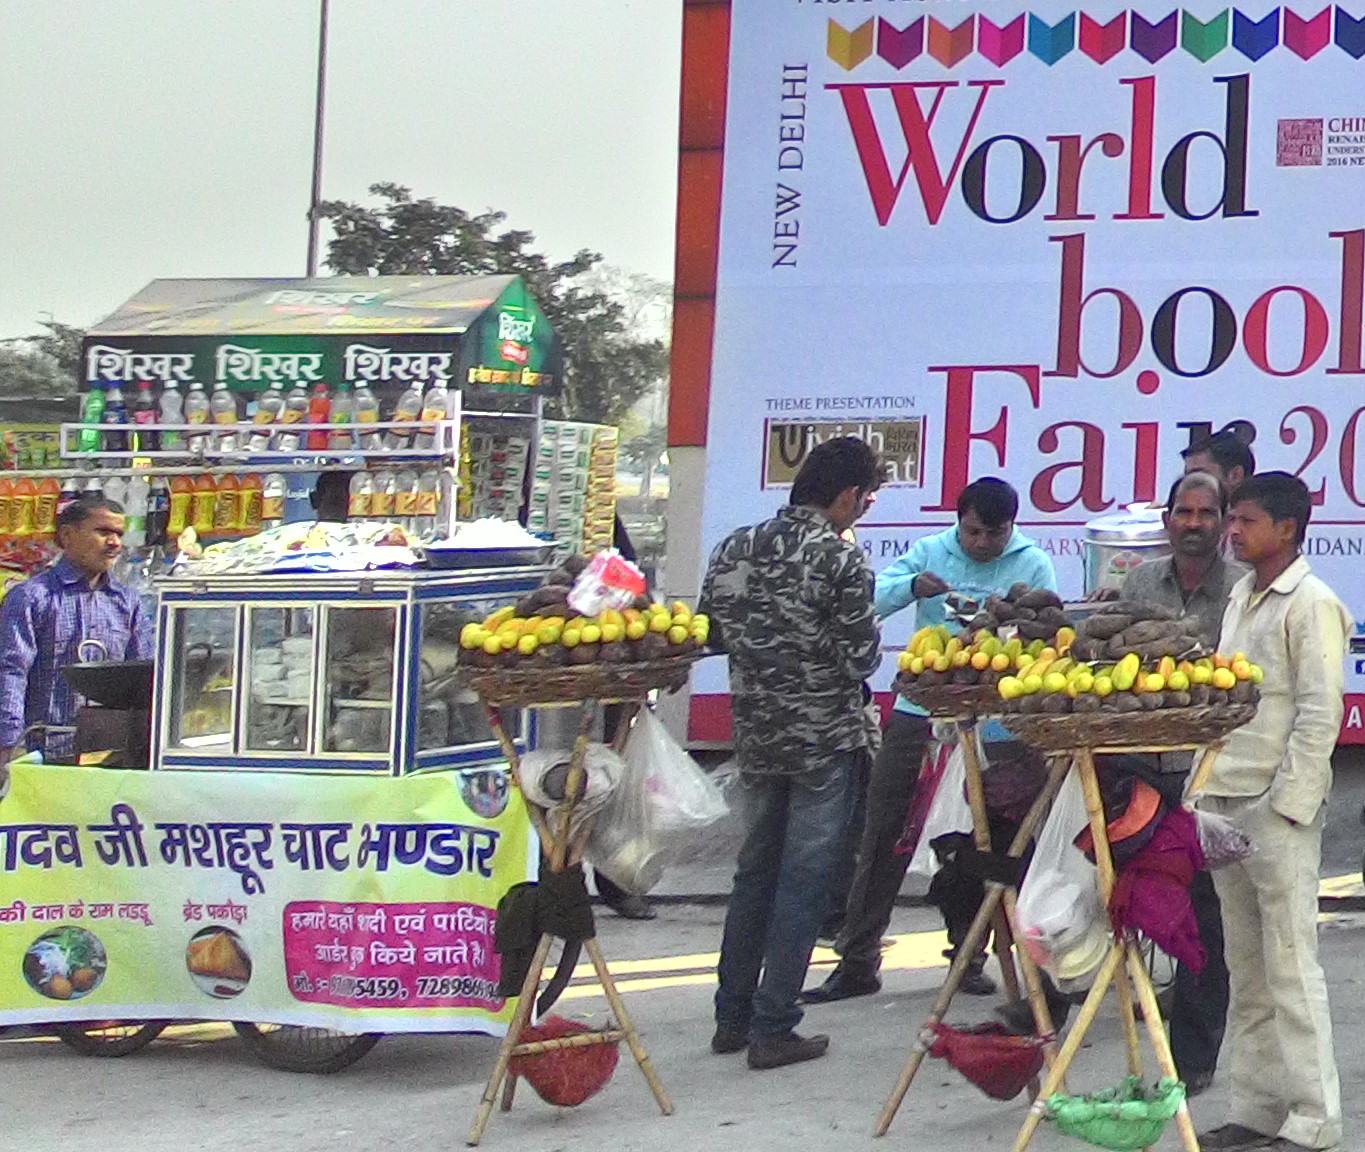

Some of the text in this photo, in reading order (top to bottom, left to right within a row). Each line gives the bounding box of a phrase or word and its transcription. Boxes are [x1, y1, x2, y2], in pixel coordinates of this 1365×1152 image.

[772, 62, 809, 270] NEW DELHI
[823, 73, 1260, 227] World
[1327, 157, 1348, 167] 2016
[86, 344, 195, 381] शिखर
[214, 343, 324, 382] शिखर
[343, 343, 453, 381] शिखर
[766, 396, 915, 411] THEME PRESENTATION
[880, 539, 909, 557] PM
[87, 803, 501, 895] जी मशहूर चाट भण्डार
[32, 902, 64, 921] दाल
[69, 899, 85, 920] के
[291, 907, 326, 931] हमारे
[394, 908, 427, 935] एवं
[370, 939, 416, 966] किये
[423, 938, 468, 965] जाते
